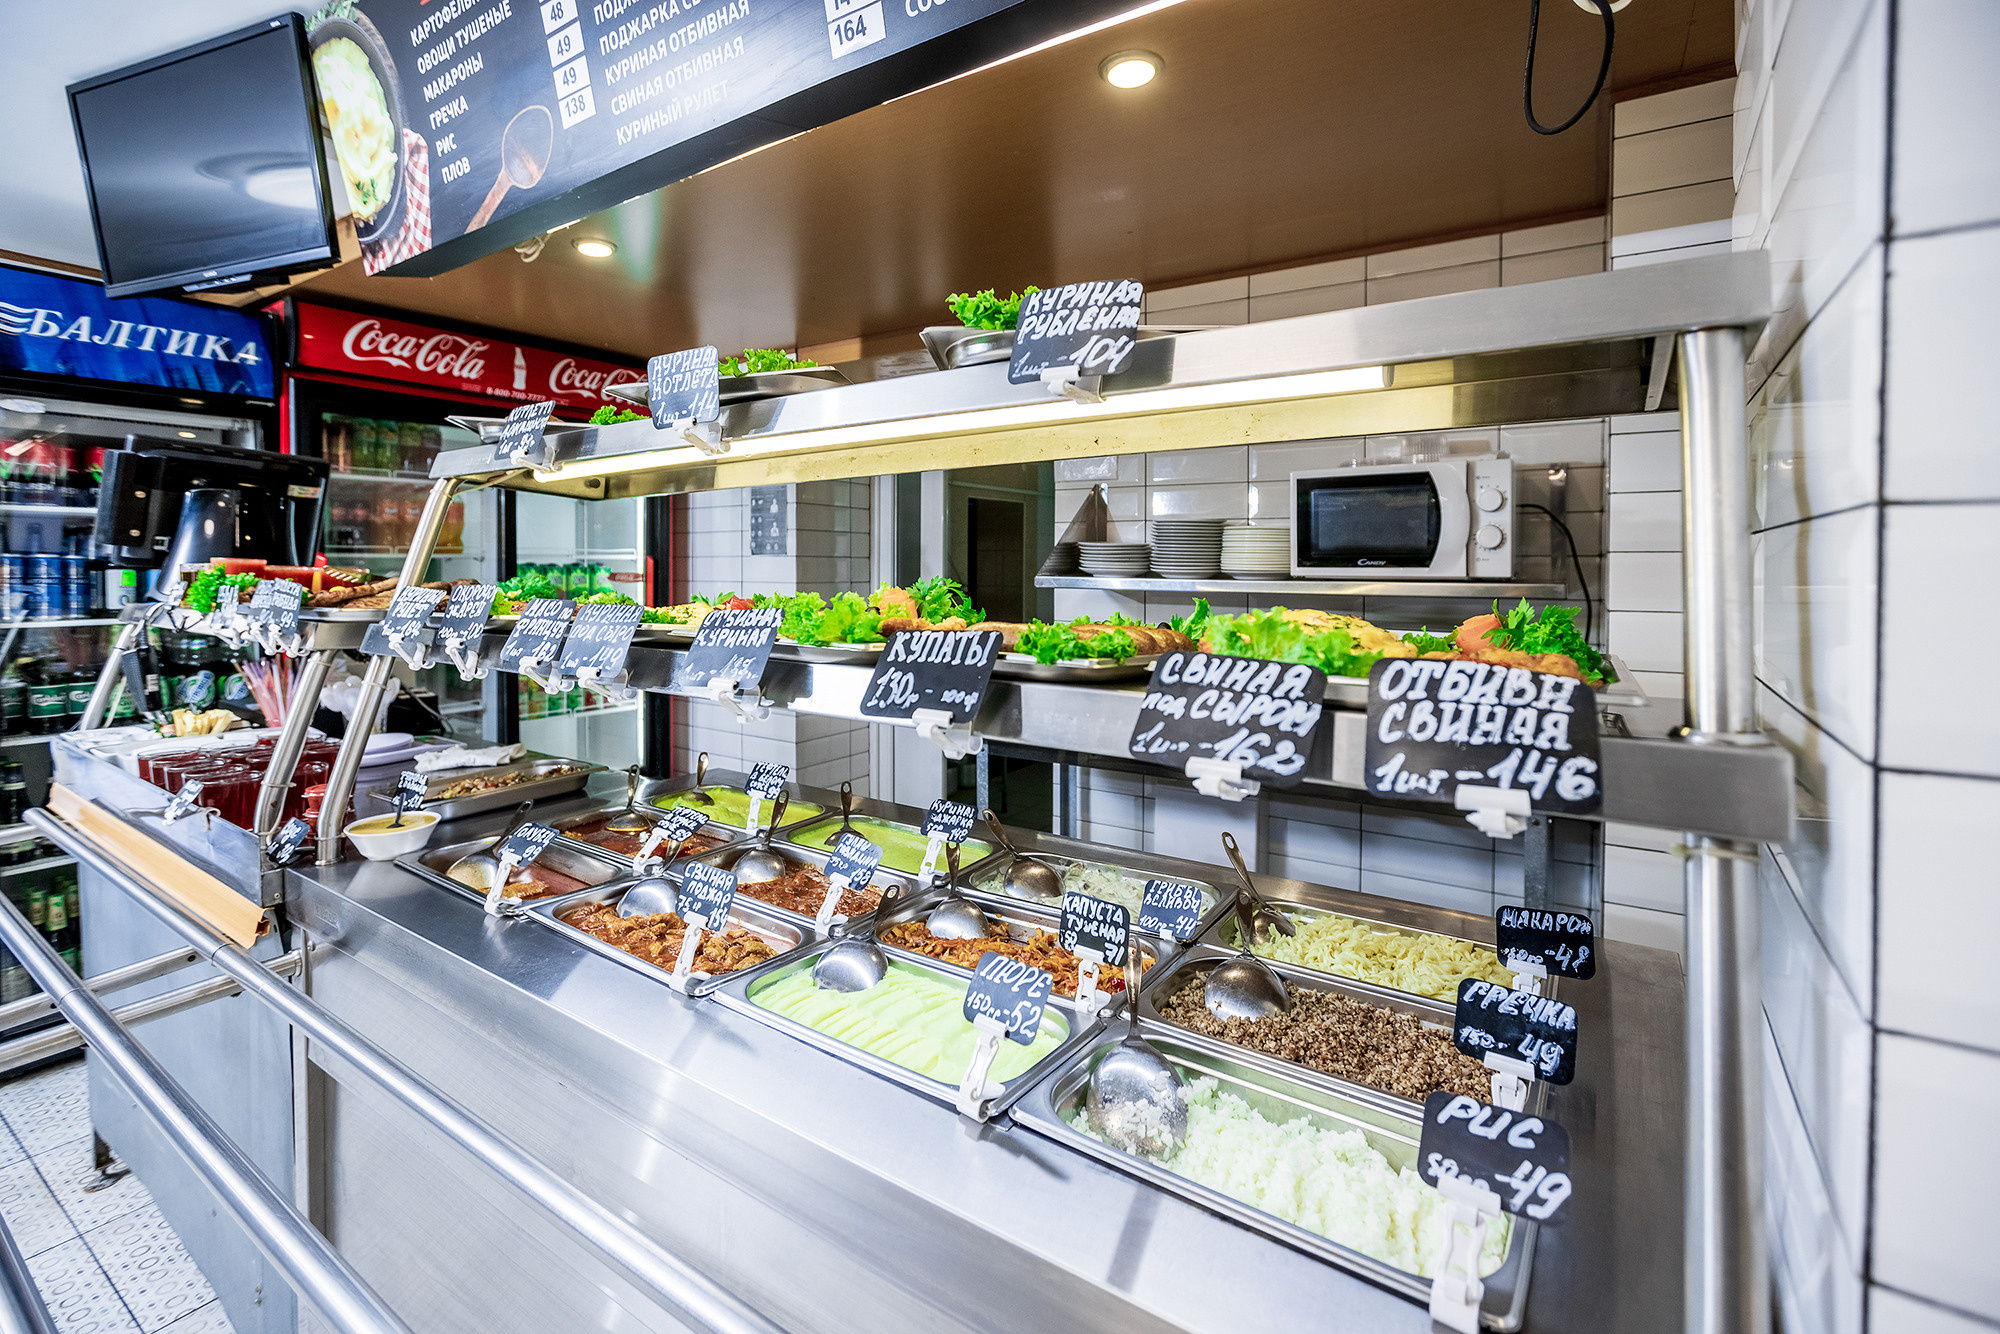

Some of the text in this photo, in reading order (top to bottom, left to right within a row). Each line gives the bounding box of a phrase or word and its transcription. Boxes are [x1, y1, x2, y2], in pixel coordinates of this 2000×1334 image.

[550, 2, 564, 22] 48
[599, 0, 681, 56] ПОДЖАРКА
[834, 15, 867, 45] 164
[416, 0, 513, 75] ОВОЩИ ТУШЕНЫЕ
[556, 35, 572, 56] 49
[604, 0, 750, 86] КУРИНАЯ ОТБИВНАЯ
[422, 51, 485, 103] МАКАРОНЫ
[562, 71, 577, 88] 49
[610, 35, 746, 117] СВИНАЯ ОТБИВНАЯ
[429, 96, 469, 131] ГРЕЧКА
[564, 98, 585, 118] 138
[616, 79, 729, 147] КУРИНЫЙ РУЛЕТ
[435, 133, 458, 159] РИС
[441, 156, 471, 185] ПЛОВ
[1025, 279, 1143, 317] КУРИНАЯ
[27, 308, 261, 366] БАЛТИКА
[342, 319, 490, 380] Coca-Cola
[652, 347, 717, 381] КУРИНАЯ
[651, 367, 718, 401] КОТЛЕТА
[580, 604, 644, 623] КУРИНАЯ
[703, 608, 784, 628] ОТБИВНАЯ
[694, 627, 772, 648] КУРИНАЯ
[886, 630, 1001, 667] КУПАТЫ
[1160, 652, 1313, 700] СВИНАЯ
[1189, 689, 1322, 738] СЫРОМ
[1378, 699, 1573, 751] СВИНАЯ
[1213, 726, 1306, 776] 162
[1486, 747, 1599, 801] 146
[684, 863, 735, 891] СВИНАЯ
[686, 880, 732, 908] ПОДЖАР
[1149, 880, 1200, 900] ГРИБЫ
[1062, 893, 1124, 927] КАПУСТА
[1066, 913, 1126, 945] ТУШЕНАЯ
[979, 955, 1054, 997] ПЮРЕ
[1005, 1000, 1041, 1039] 52
[1463, 981, 1578, 1031] ГРЕЧКА
[1517, 1033, 1565, 1077] 49
[1436, 1095, 1545, 1150] РИС
[1510, 1159, 1573, 1220] 49
